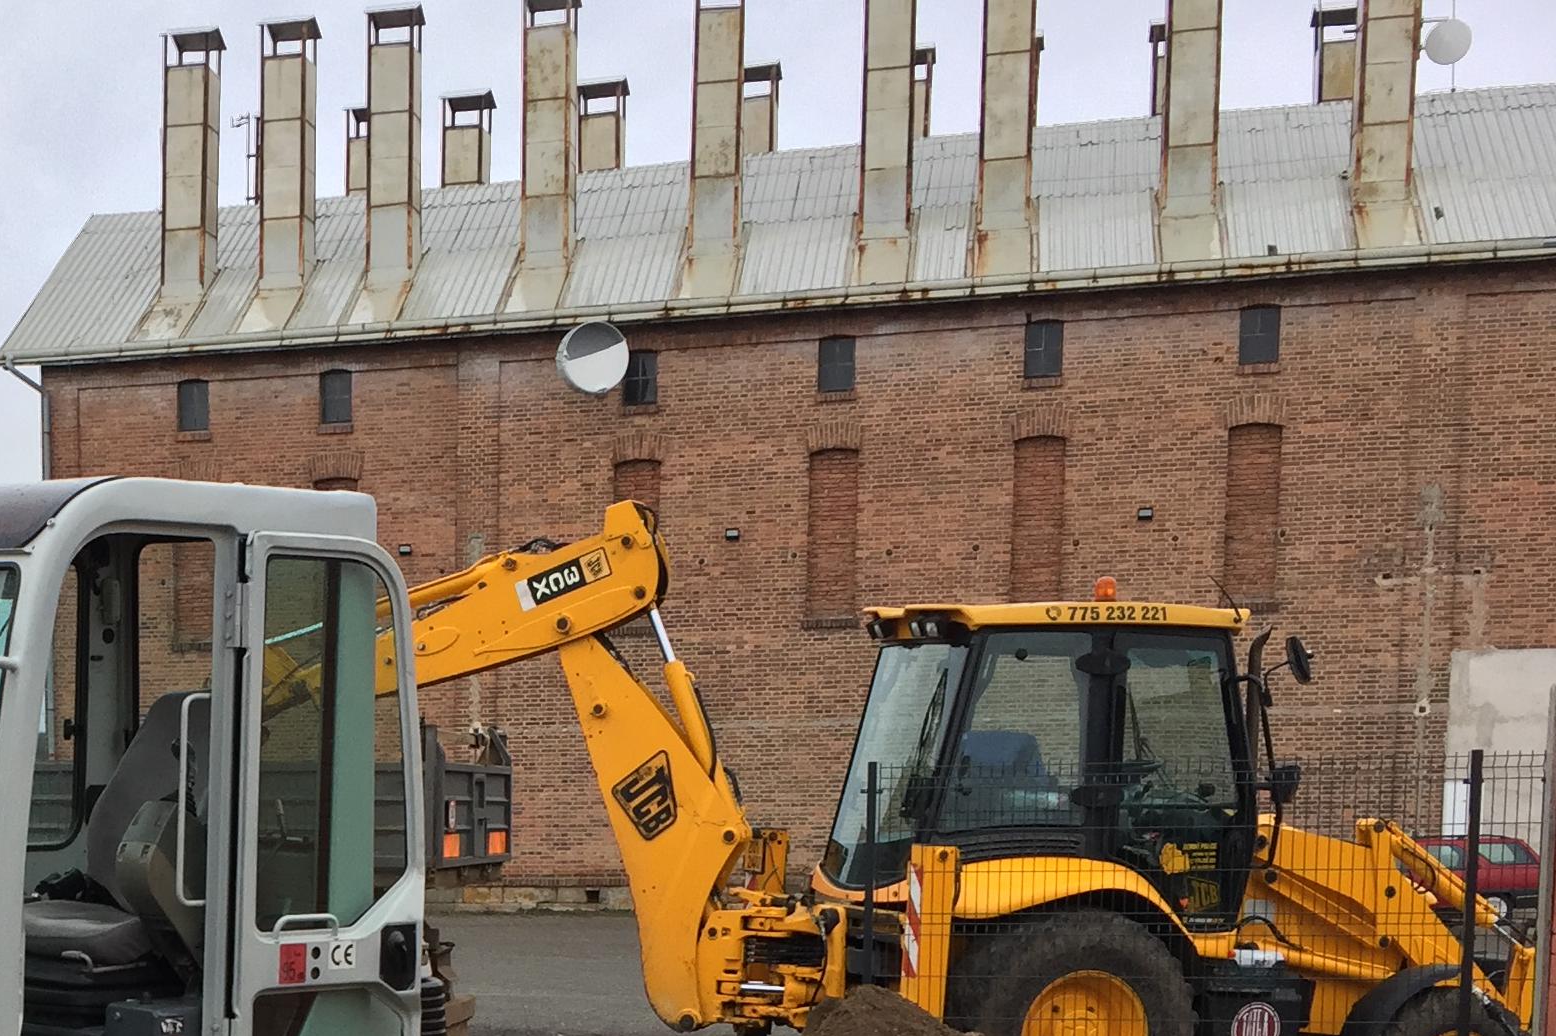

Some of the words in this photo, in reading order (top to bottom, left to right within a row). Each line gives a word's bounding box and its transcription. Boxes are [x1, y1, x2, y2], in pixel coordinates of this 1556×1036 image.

[532, 566, 580, 600] 3CX
[1067, 606, 1100, 621] 775
[1105, 605, 1136, 621] 232
[1141, 605, 1167, 621] 221
[620, 765, 672, 833] JCB
[331, 944, 354, 966] CE
